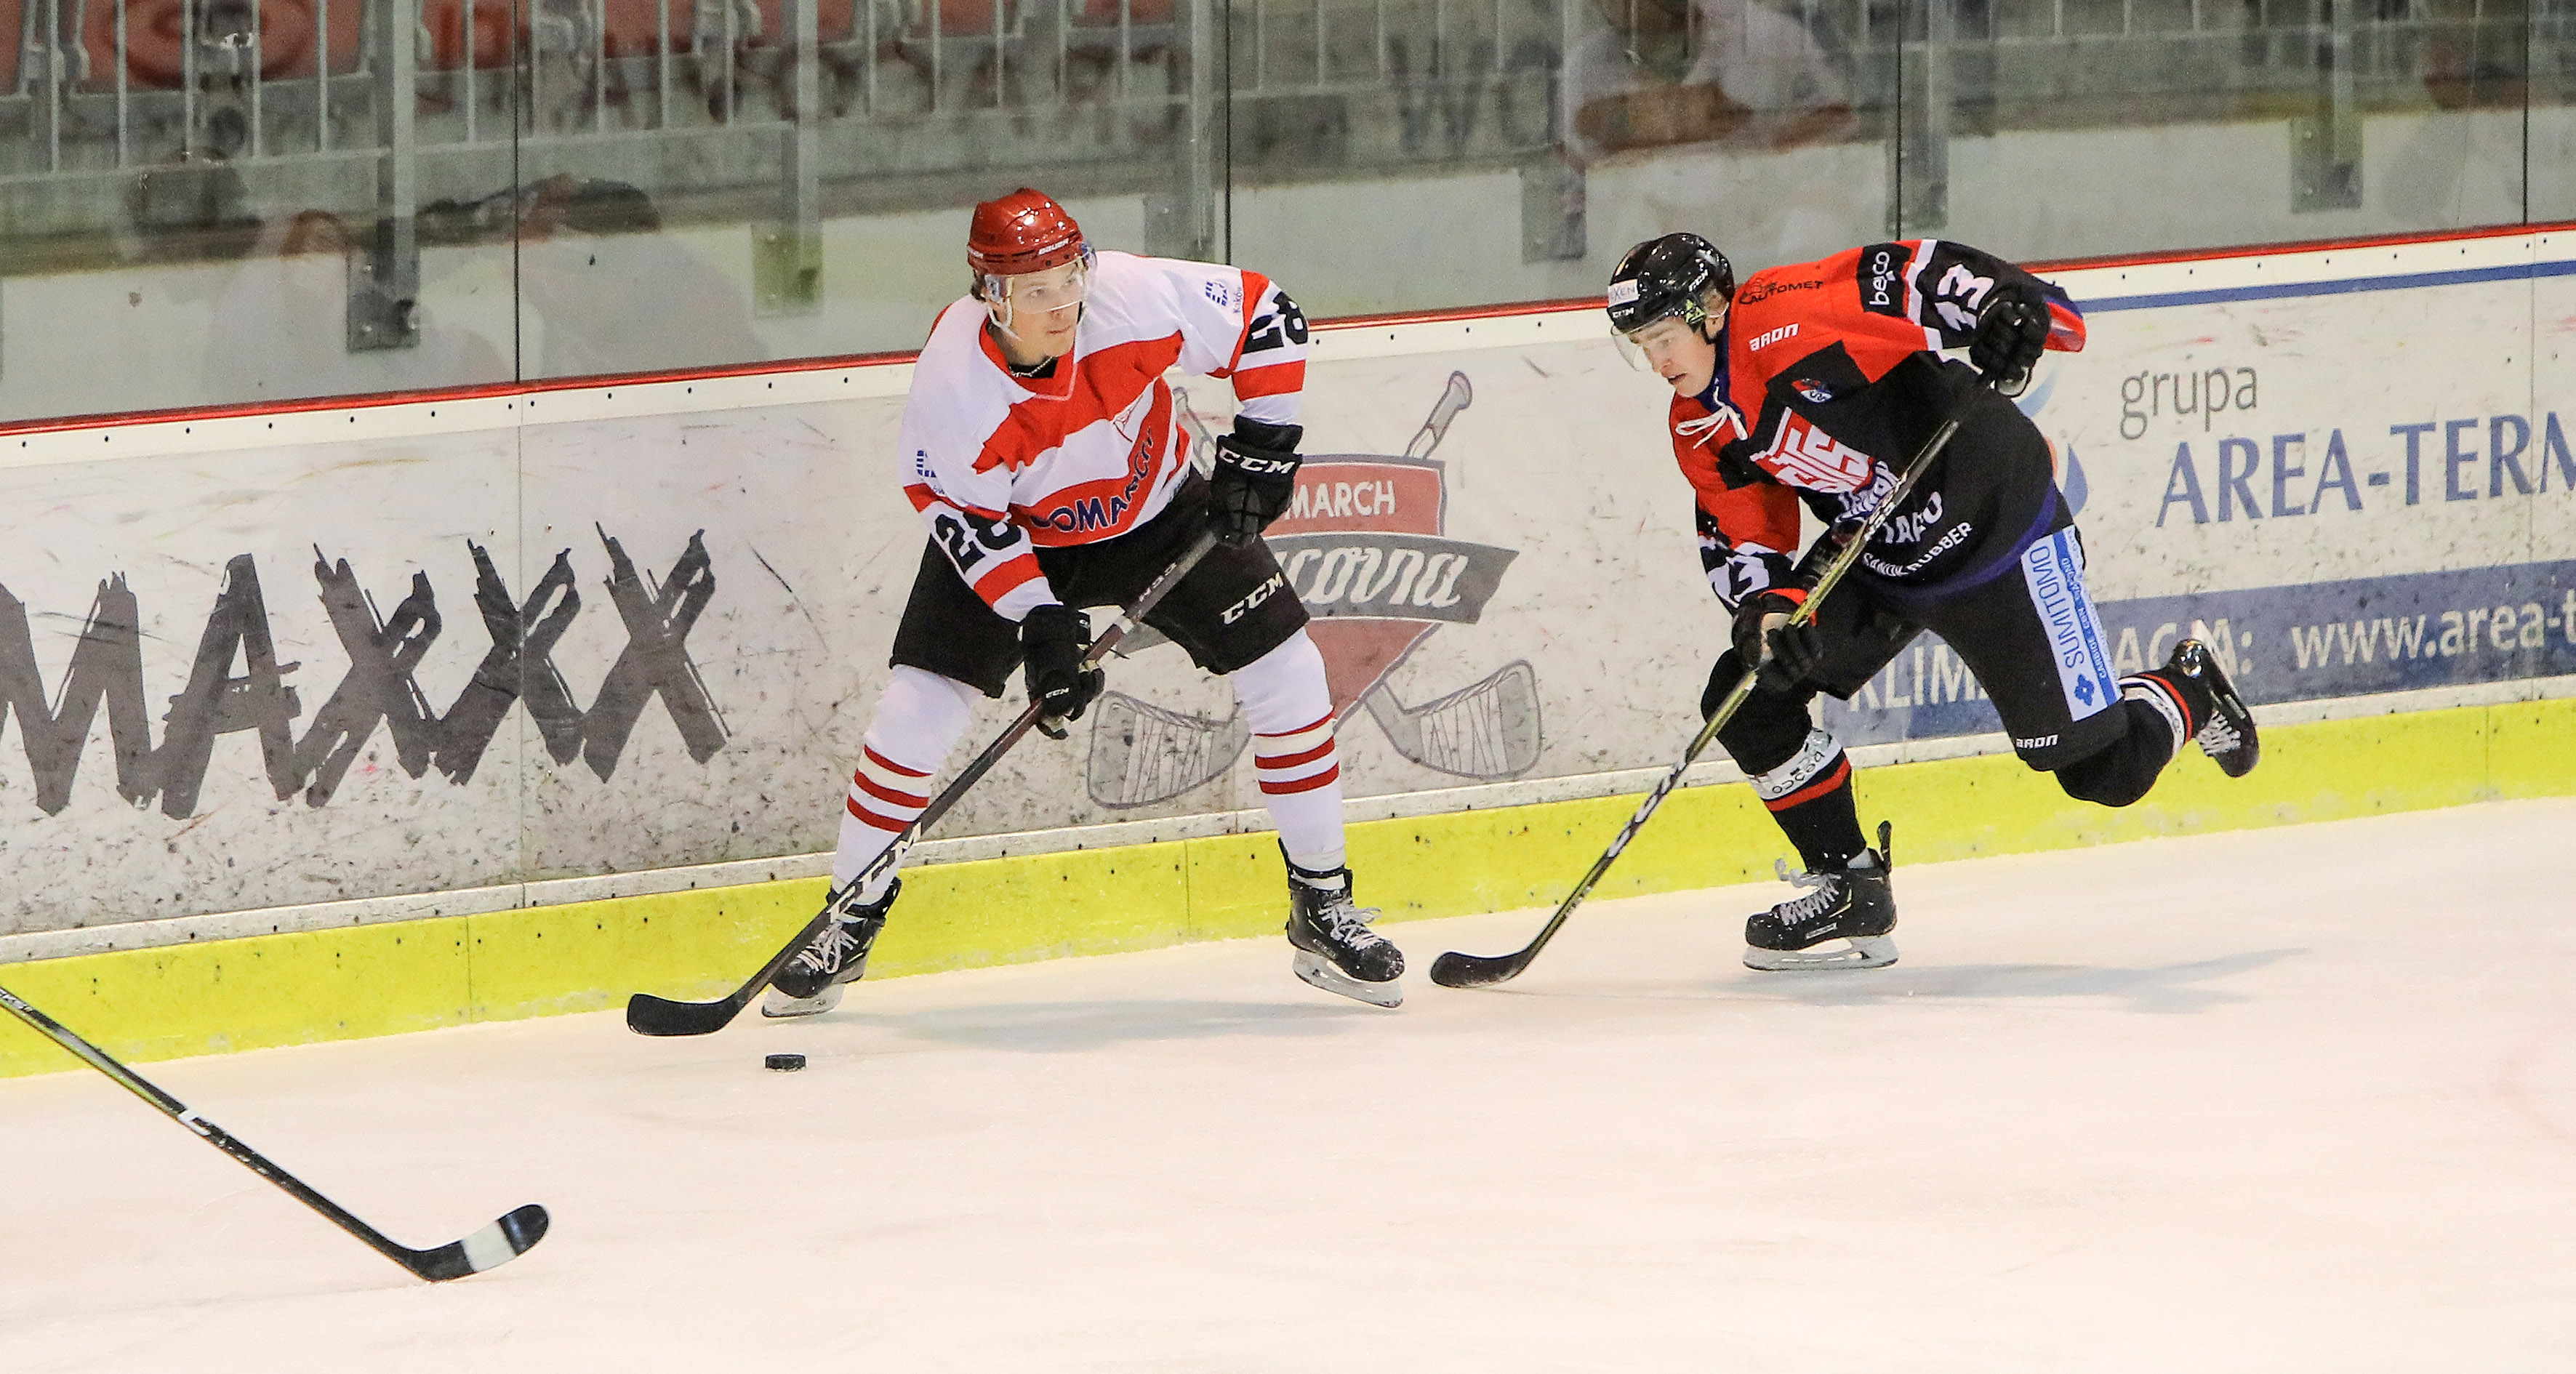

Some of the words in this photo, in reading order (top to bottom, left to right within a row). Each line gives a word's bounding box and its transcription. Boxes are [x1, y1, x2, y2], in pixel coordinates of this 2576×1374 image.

[1241, 291, 1308, 354] 28
[1934, 262, 1996, 332] 13
[2119, 365, 2258, 441] grupa
[1219, 445, 1296, 474] CCM
[1283, 480, 1397, 520] MARCH
[934, 513, 1022, 575] 28
[1906, 521, 1973, 572] RUBBER
[1219, 571, 1285, 625] CCM
[2029, 545, 2085, 669] SUMITOMO
[1847, 644, 1989, 712] KLIM
[2290, 588, 2576, 672] www.area-t
